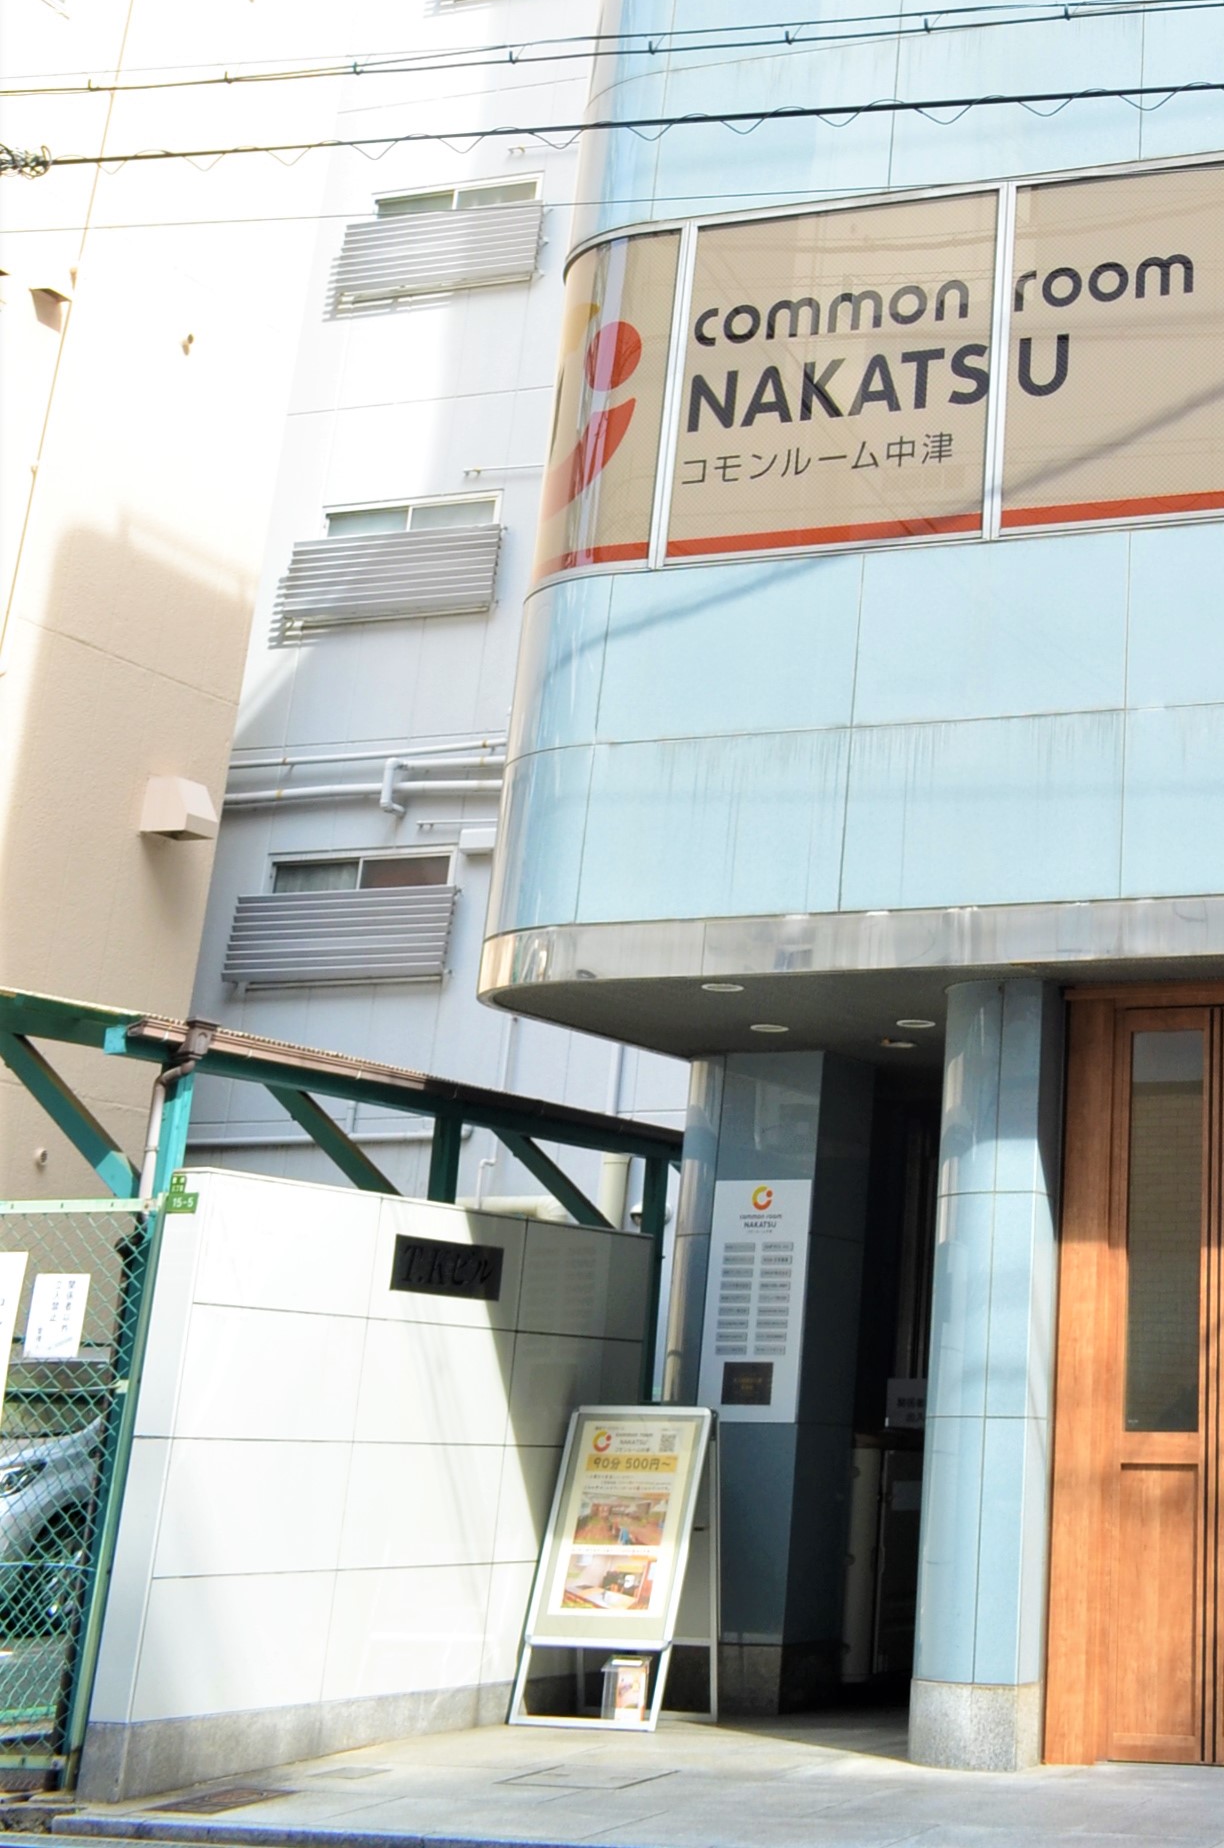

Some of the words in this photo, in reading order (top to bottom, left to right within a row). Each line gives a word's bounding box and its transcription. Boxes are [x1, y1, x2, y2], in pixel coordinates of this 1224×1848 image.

[693, 279, 969, 348] common
[1013, 252, 1195, 312] room
[686, 333, 1070, 434] NAKATSU
[681, 432, 954, 487] コモンルーム中津
[172, 1197, 194, 1208] 15-5
[593, 1457, 621, 1470] 90分
